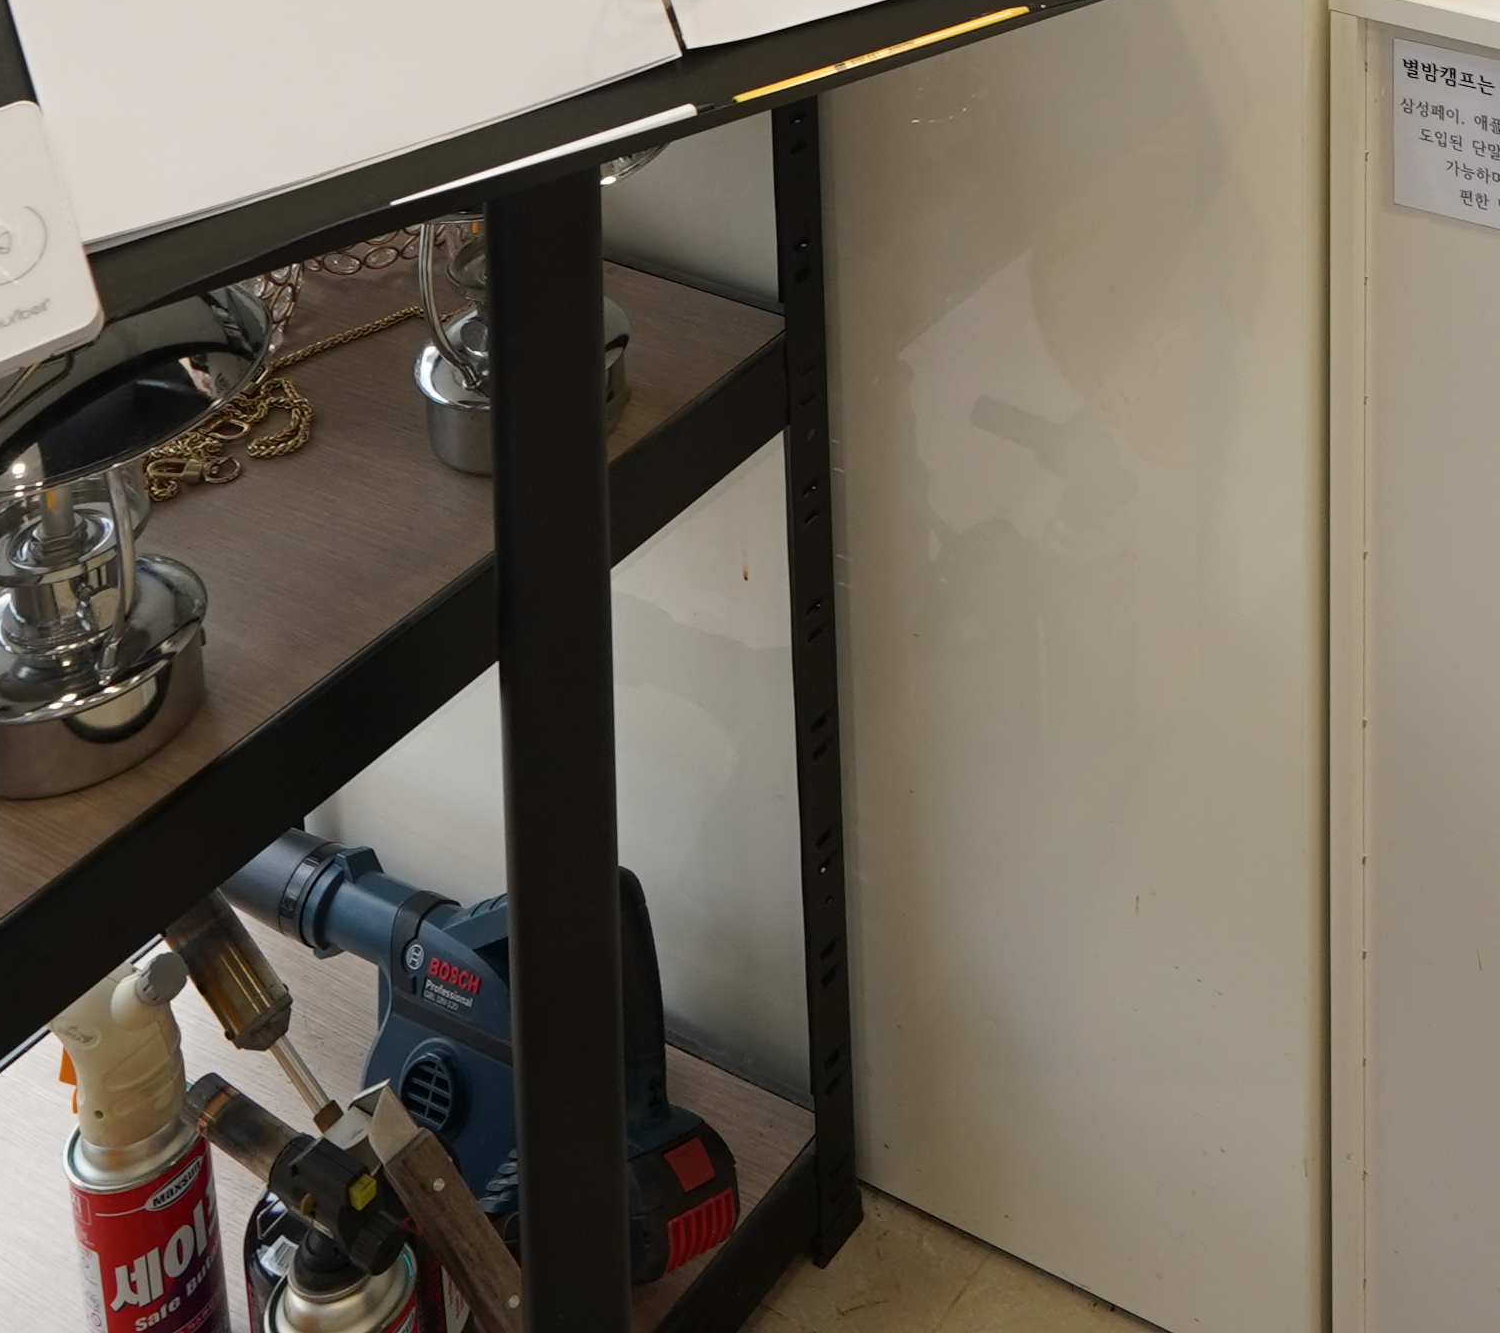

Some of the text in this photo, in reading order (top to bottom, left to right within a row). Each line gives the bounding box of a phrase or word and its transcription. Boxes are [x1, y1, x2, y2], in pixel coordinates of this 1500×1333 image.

[1402, 57, 1496, 97] 별밤캠프는
[425, 979, 474, 1008] Professional
[428, 958, 481, 994] BOSCH
